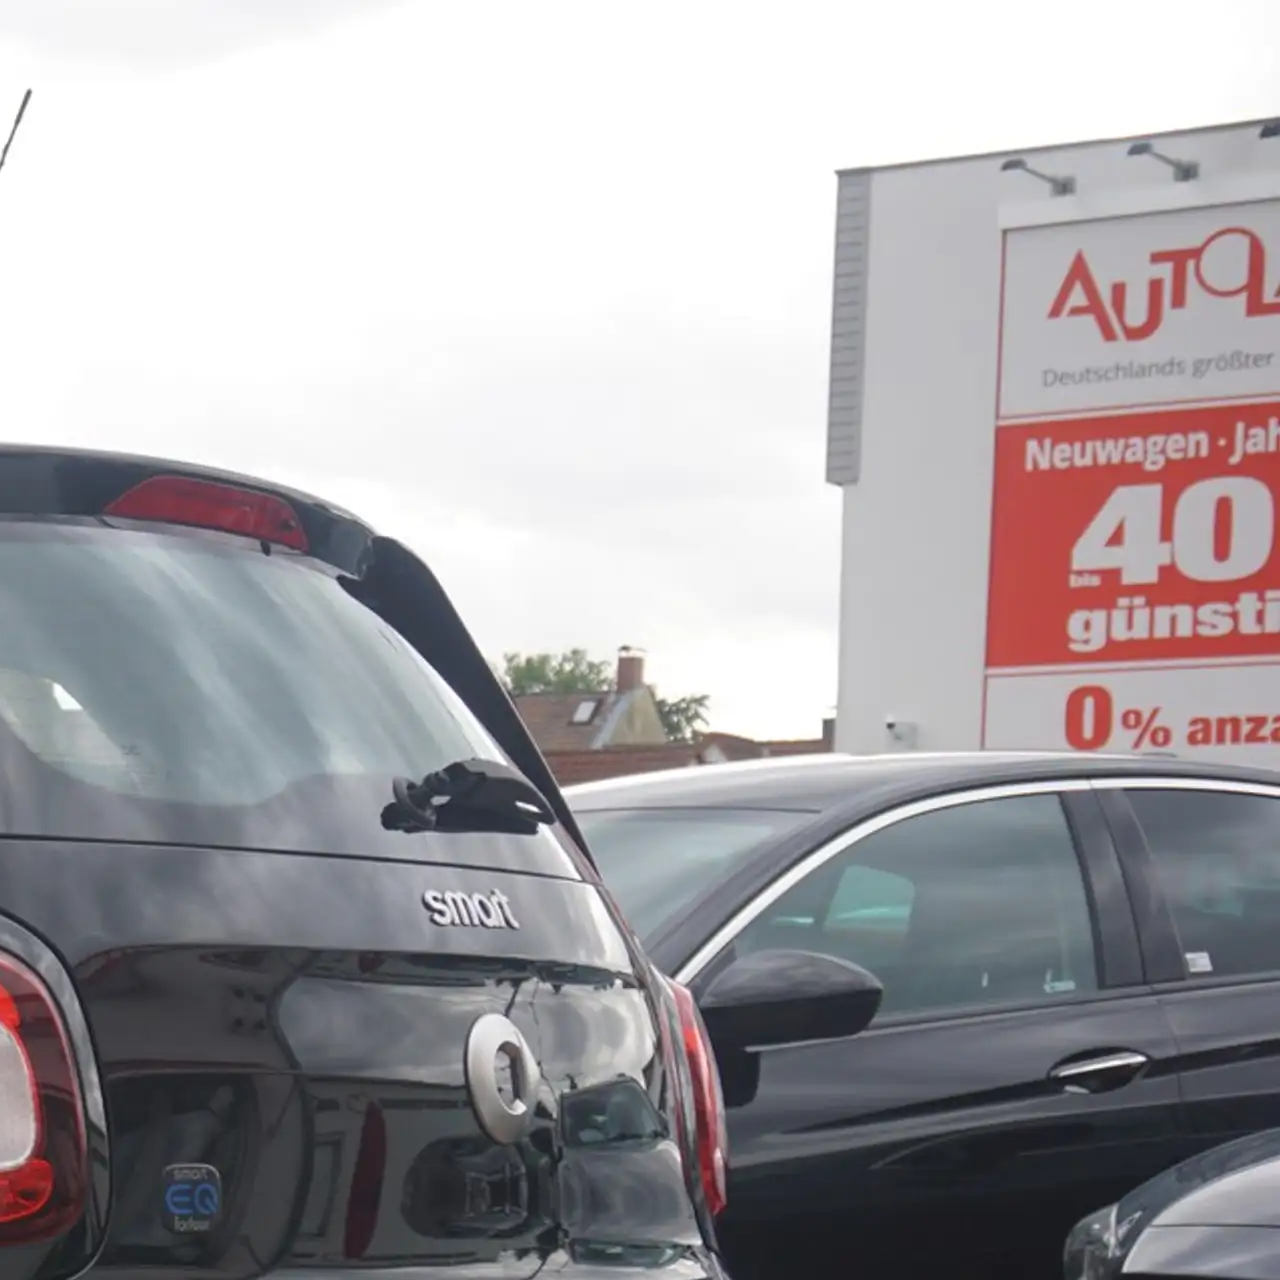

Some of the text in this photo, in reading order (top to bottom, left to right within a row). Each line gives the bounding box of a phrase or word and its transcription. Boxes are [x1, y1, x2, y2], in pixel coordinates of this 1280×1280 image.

[1047, 227, 1280, 342] AUTOL
[1042, 348, 1276, 388] Deutschlands größter
[1024, 430, 1210, 473] Neuwagen
[1071, 476, 1274, 586] 40
[423, 888, 521, 931] smart
[165, 1183, 219, 1215] EQ
